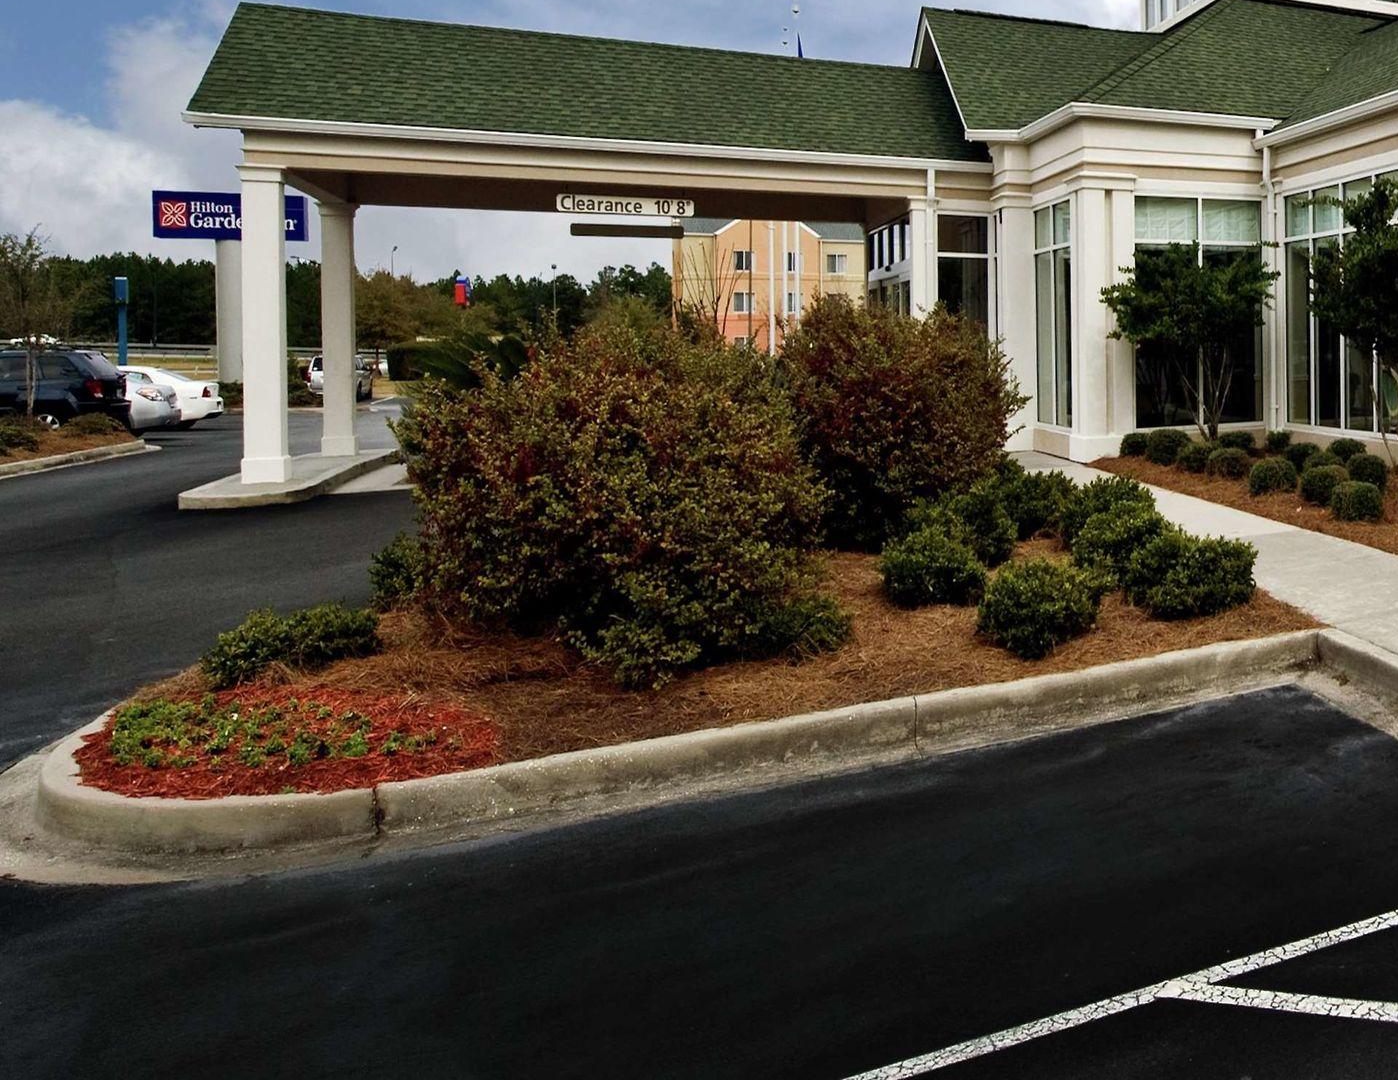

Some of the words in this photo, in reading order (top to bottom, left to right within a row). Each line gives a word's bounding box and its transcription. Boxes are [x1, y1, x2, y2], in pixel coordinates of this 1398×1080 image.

[190, 201, 233, 213] Hilton
[560, 194, 642, 213] Clearance
[190, 213, 242, 229] Garde
